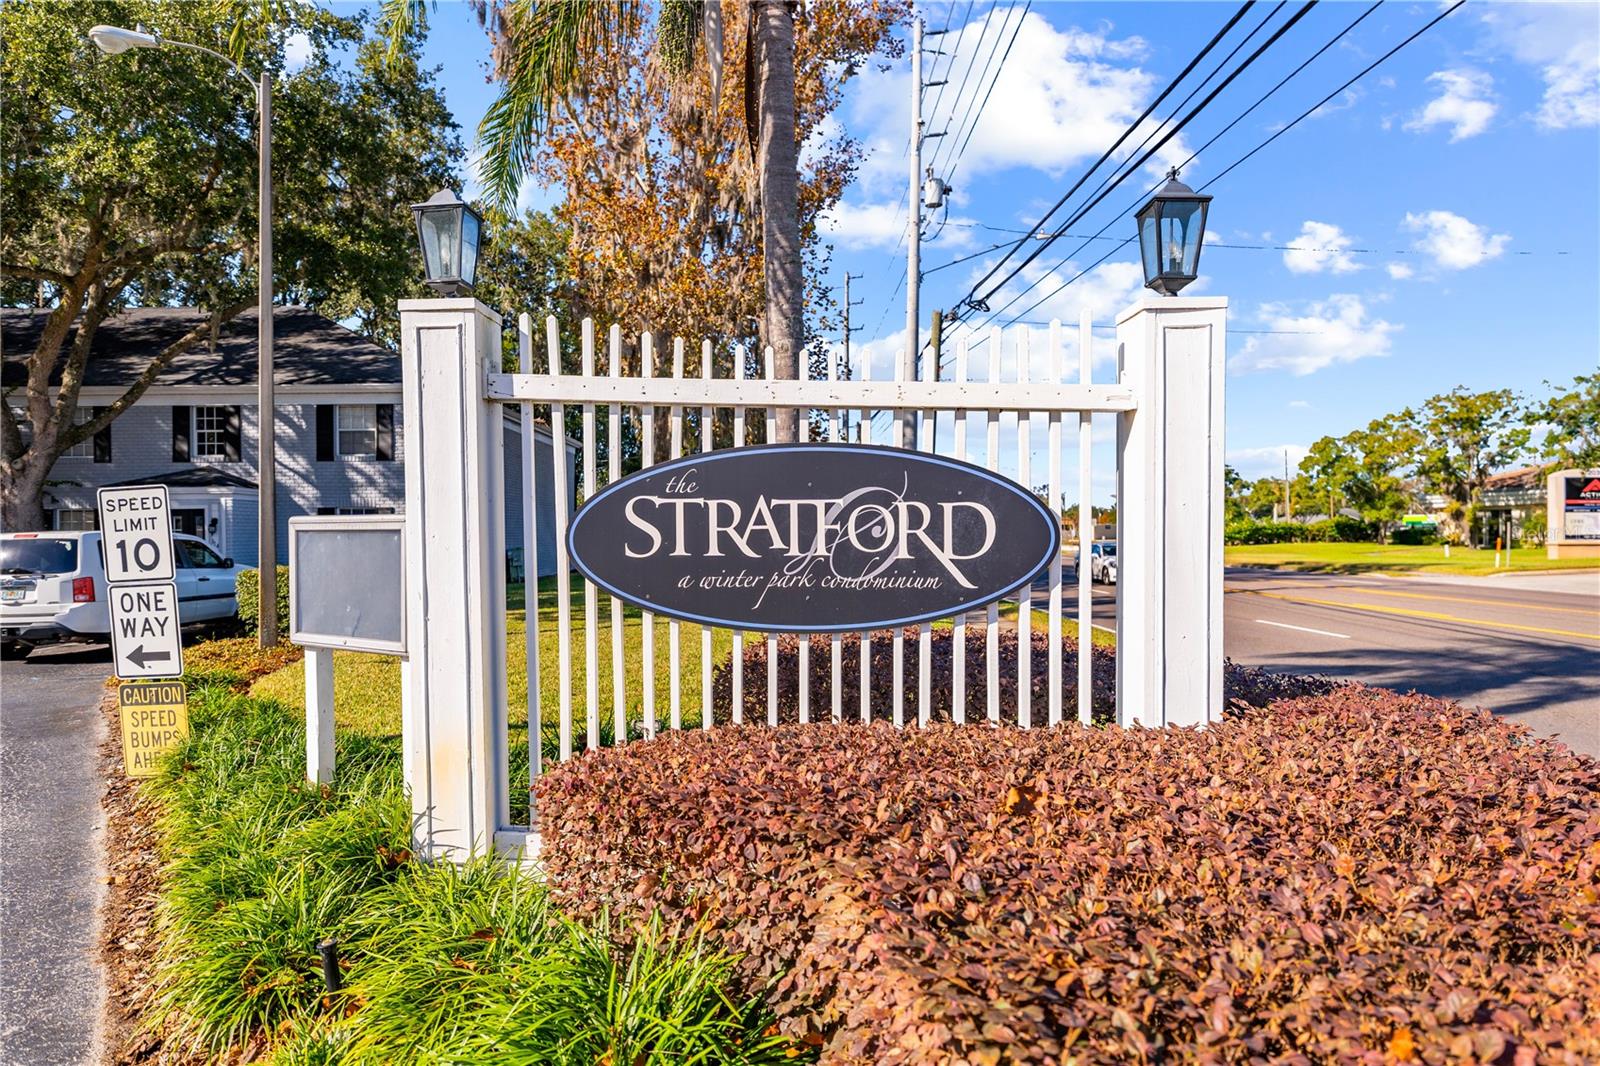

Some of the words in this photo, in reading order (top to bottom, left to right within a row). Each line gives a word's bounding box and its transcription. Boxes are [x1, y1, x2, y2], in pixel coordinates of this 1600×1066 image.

[665, 468, 699, 494] the
[106, 497, 162, 512] SPEED
[113, 517, 157, 532] LIMIT
[625, 494, 996, 589] STRATFORD
[116, 538, 160, 572] 10
[678, 575, 695, 589] a
[700, 569, 763, 590] winter
[752, 557, 824, 610] park
[821, 557, 943, 590] condominium
[120, 592, 166, 613] ONE
[120, 616, 169, 638] WAY
[123, 687, 181, 704] CAUTION
[131, 710, 176, 727] SPEED
